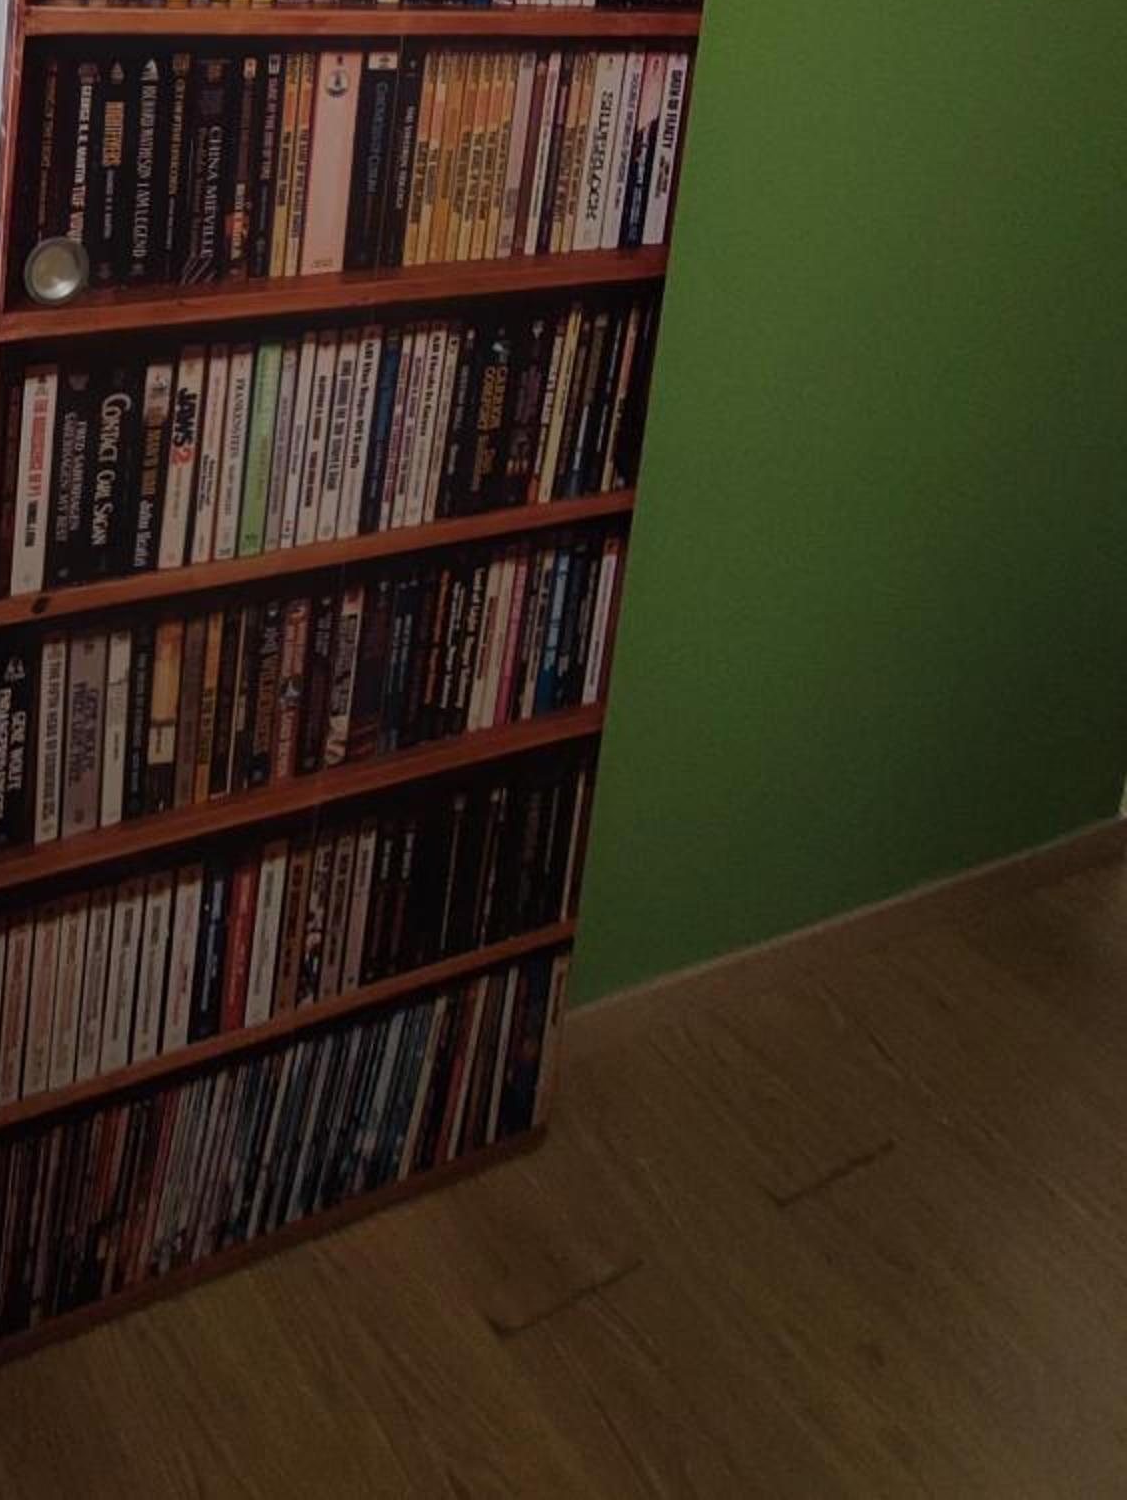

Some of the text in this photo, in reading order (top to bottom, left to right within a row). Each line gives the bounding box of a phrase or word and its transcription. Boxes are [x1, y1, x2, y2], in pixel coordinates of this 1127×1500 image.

[204, 125, 223, 181] CHINA
[131, 209, 150, 258] LEGEND
[73, 419, 87, 451] FRED
[171, 386, 198, 465] JAWS 2
[55, 514, 69, 543] BEST
[6, 746, 24, 792] WOLFE
